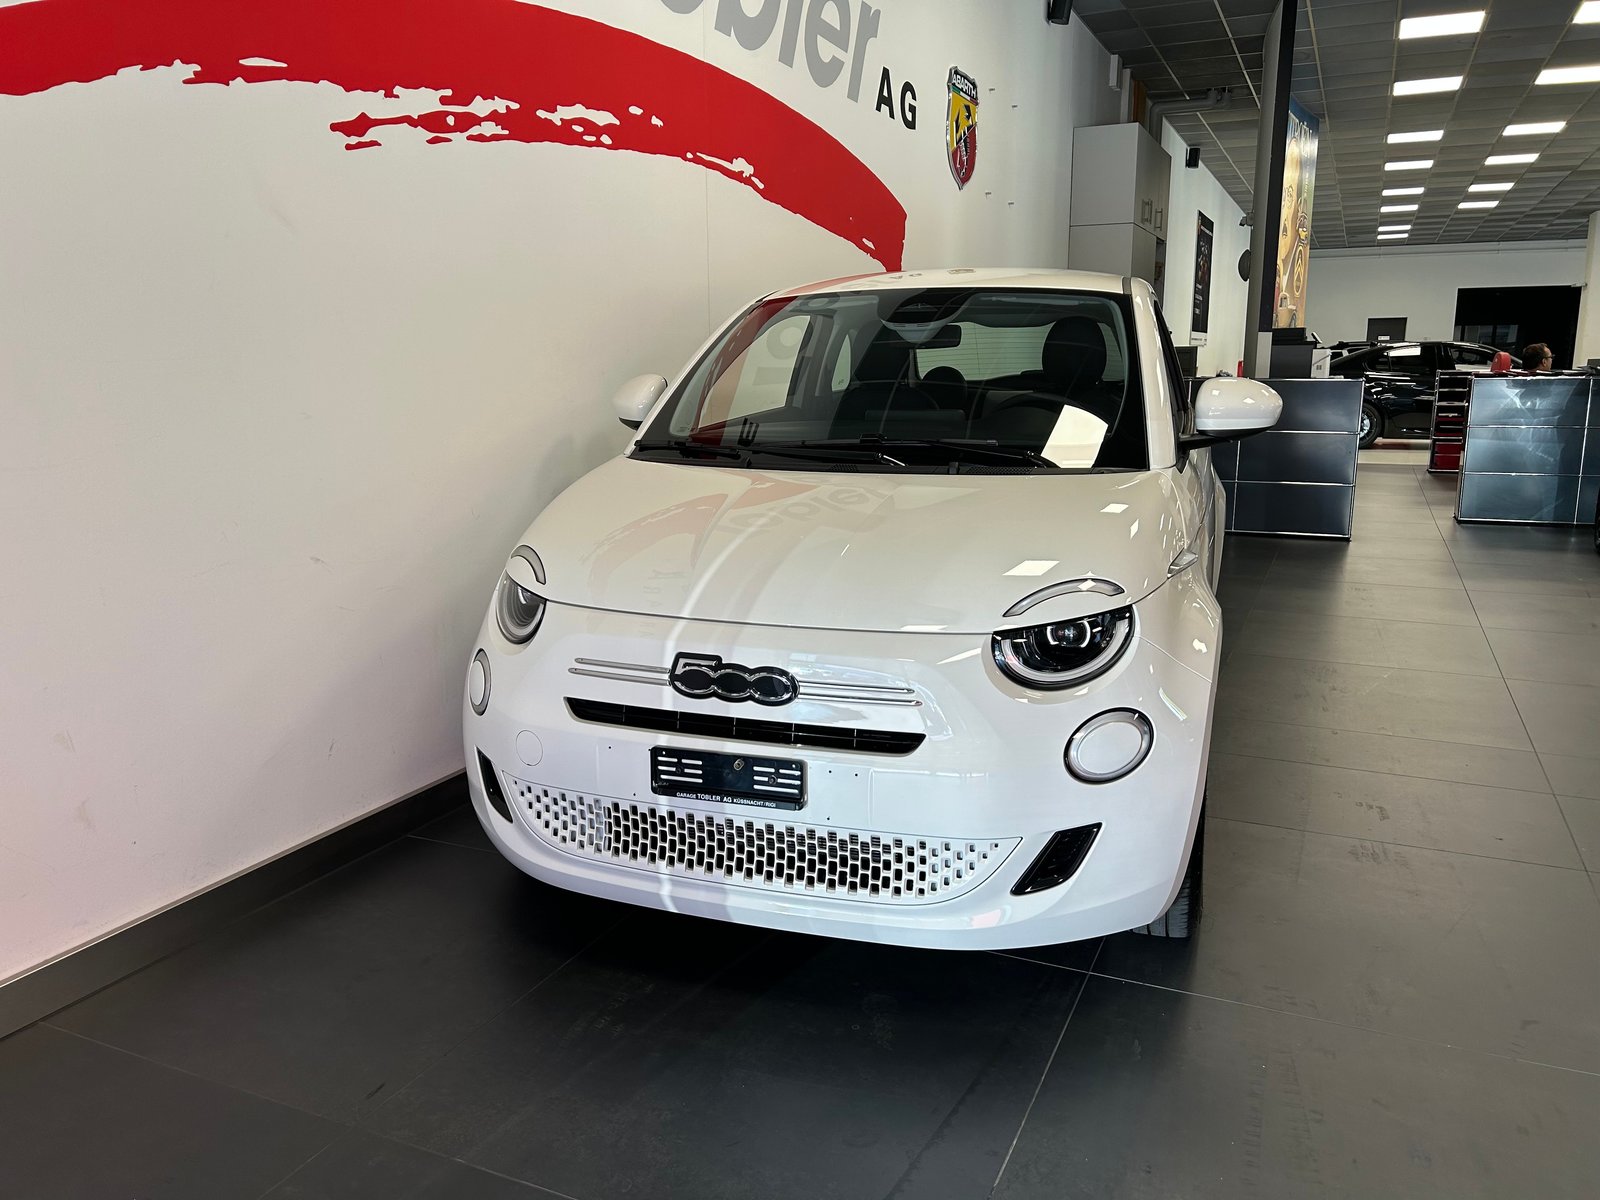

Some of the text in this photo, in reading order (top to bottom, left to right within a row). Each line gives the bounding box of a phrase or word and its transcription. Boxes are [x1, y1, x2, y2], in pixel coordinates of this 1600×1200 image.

[875, 66, 917, 130] AG
[951, 73, 977, 99] ABARTH
[671, 652, 800, 706] 500
[697, 794, 721, 802] TOBLER
